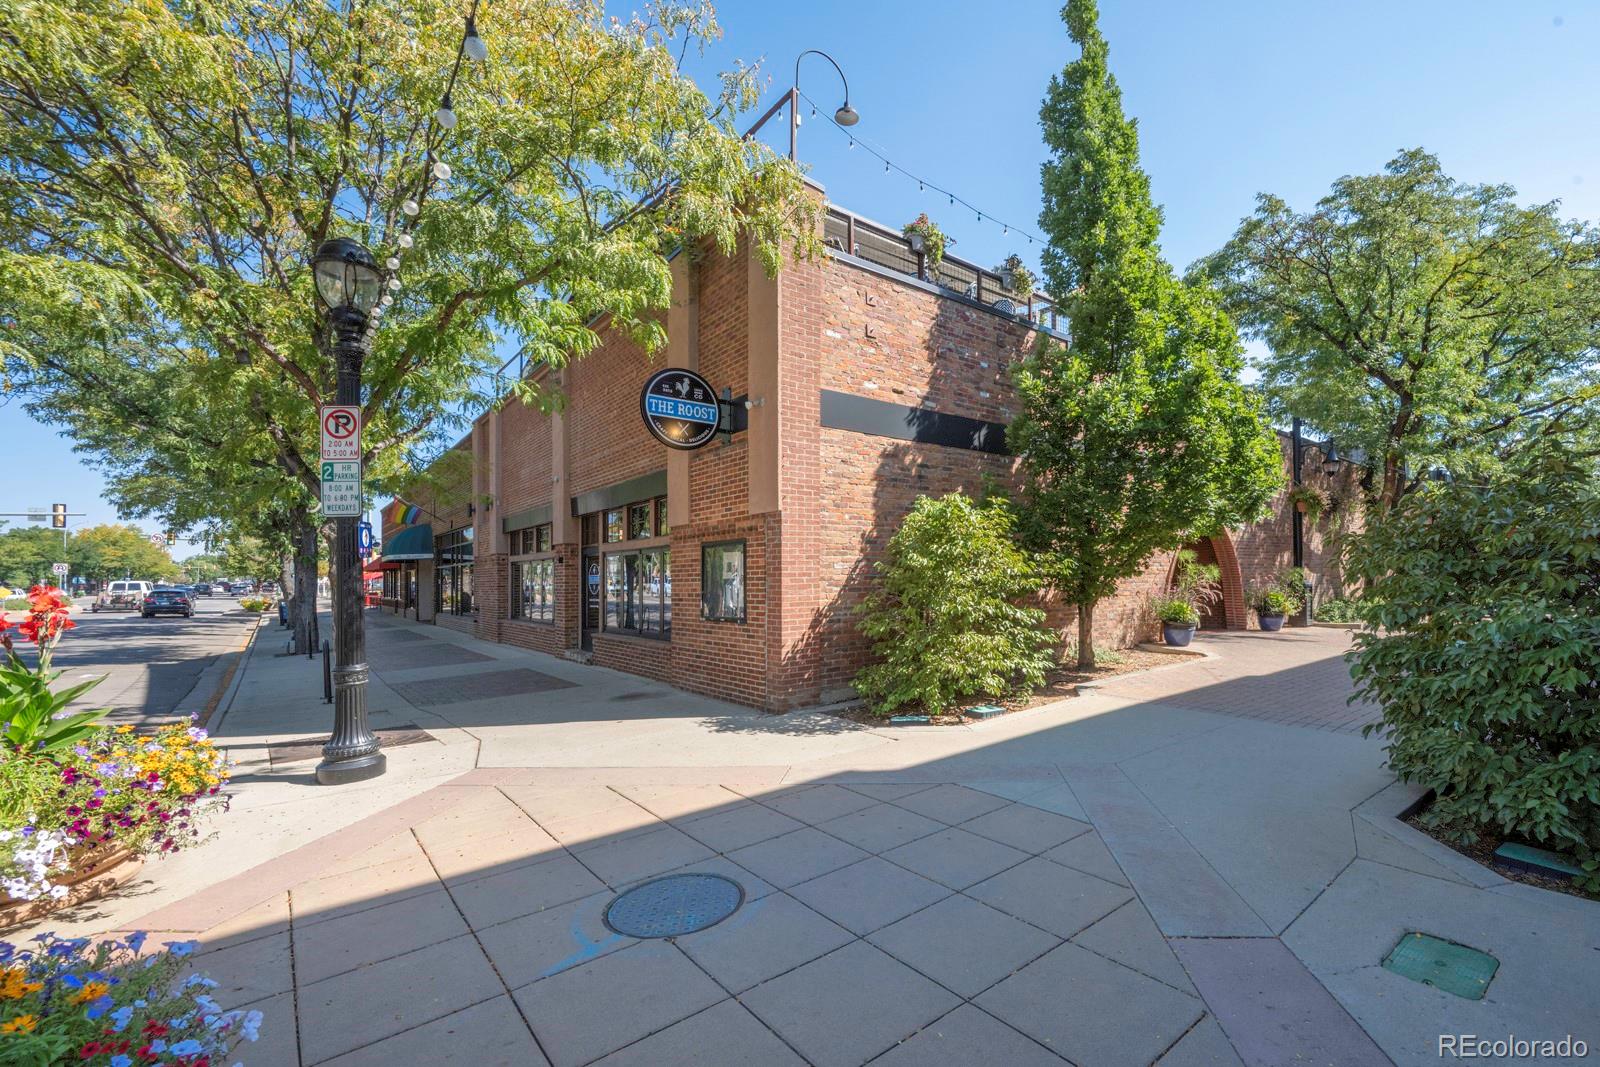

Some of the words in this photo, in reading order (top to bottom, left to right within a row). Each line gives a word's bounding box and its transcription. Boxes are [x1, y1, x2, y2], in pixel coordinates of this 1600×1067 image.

[649, 398, 674, 414] THE
[677, 403, 716, 420] ROOST
[323, 466, 332, 479] 2
